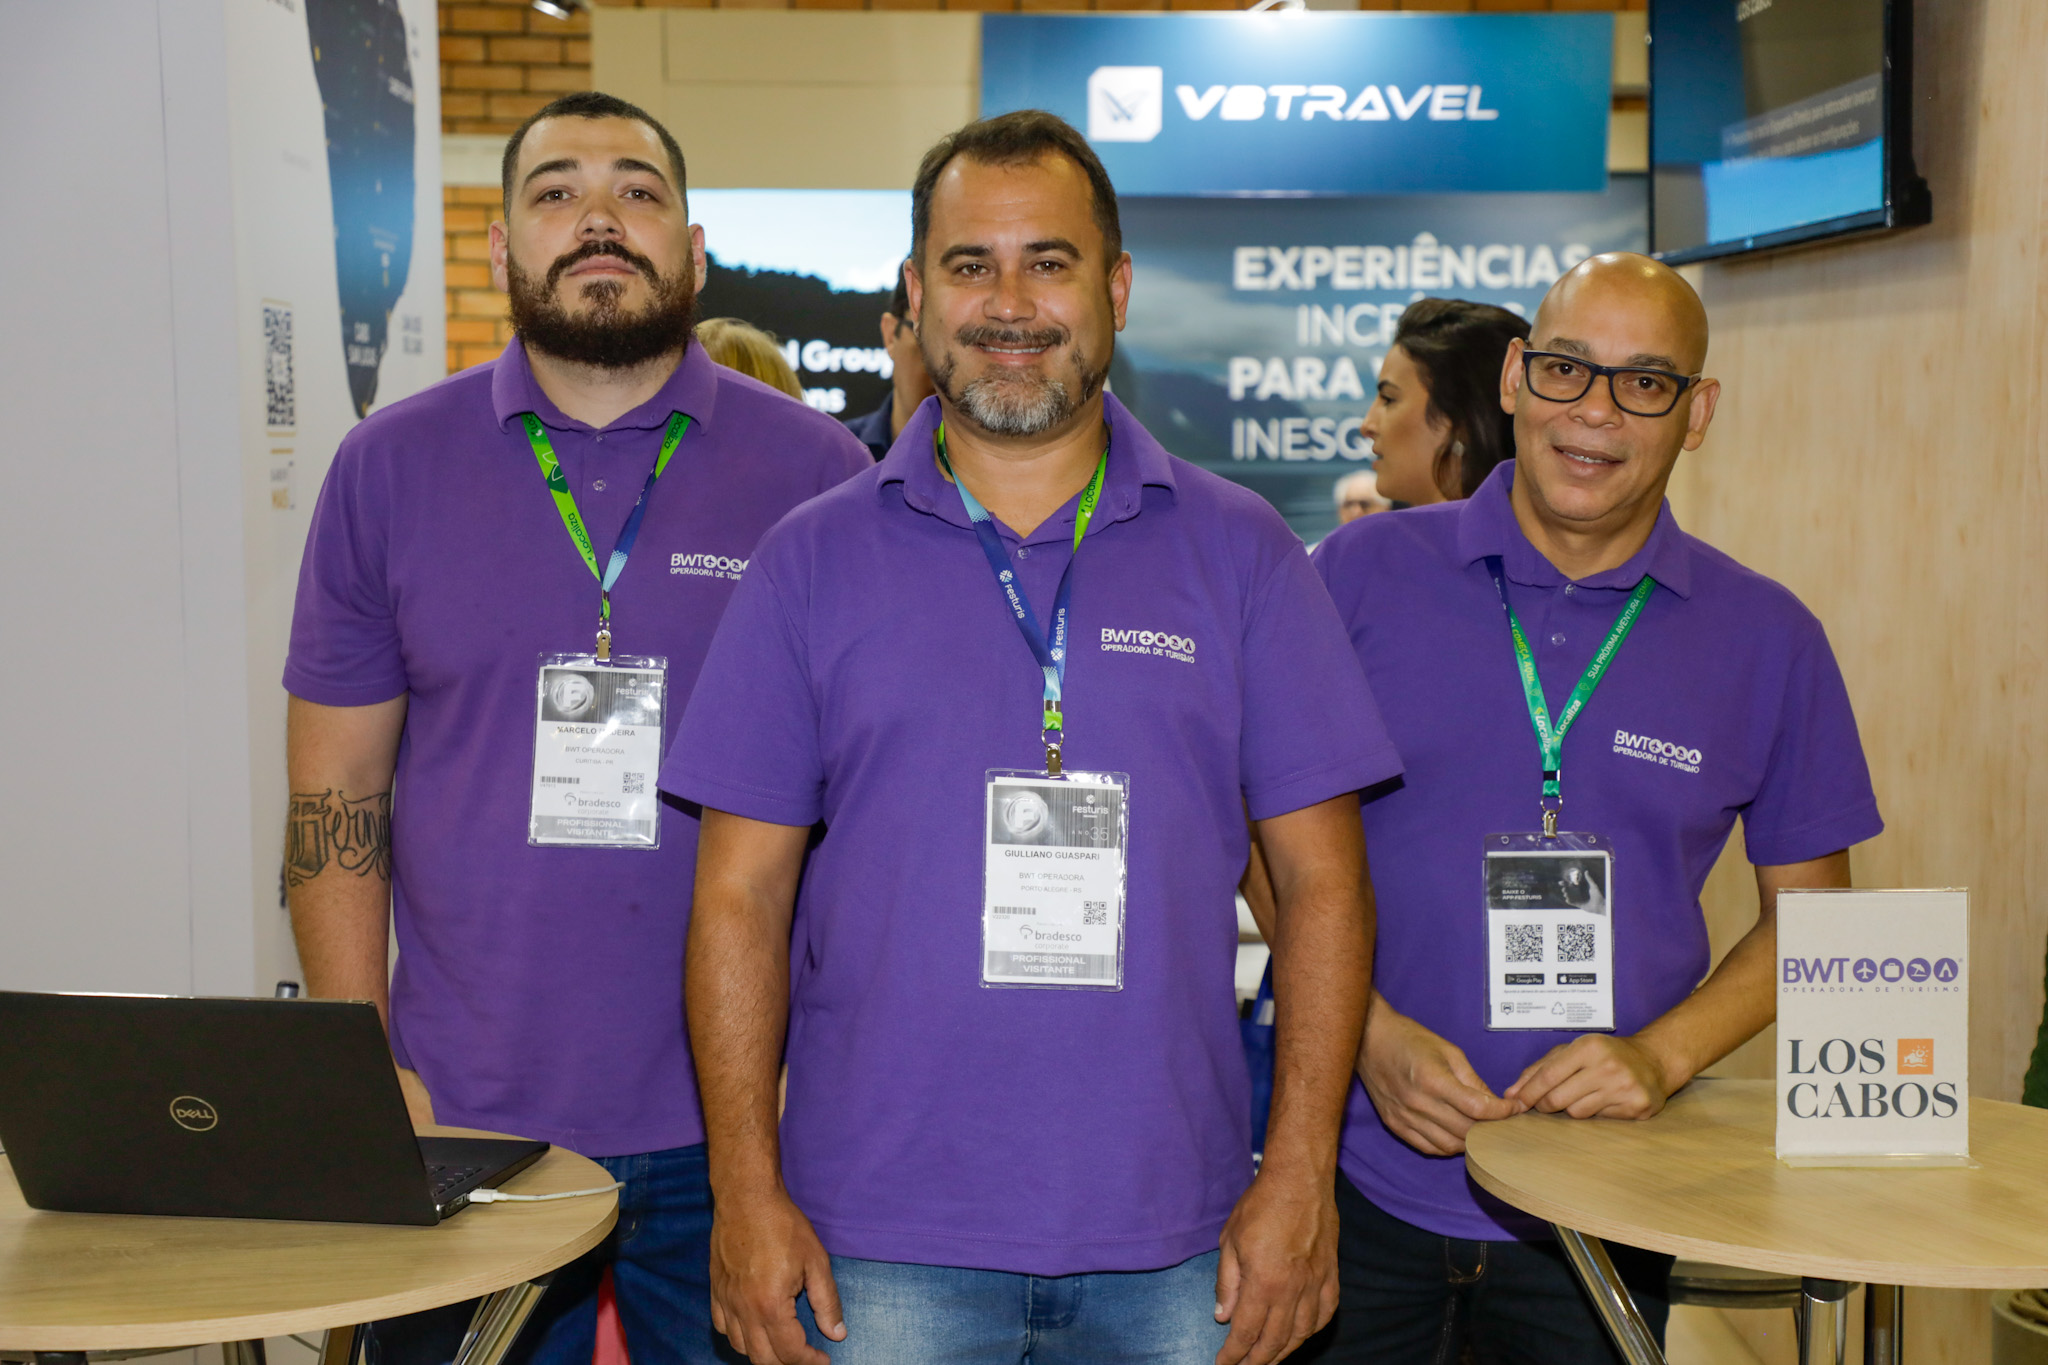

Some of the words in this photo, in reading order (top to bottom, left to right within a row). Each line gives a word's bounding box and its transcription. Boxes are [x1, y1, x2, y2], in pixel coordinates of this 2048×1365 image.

[1176, 84, 1499, 121] VBTRAVEL
[801, 339, 894, 379] Group
[1229, 357, 1365, 399] PARA
[1233, 418, 1376, 461] INESQ
[568, 512, 592, 554] Localiza
[671, 553, 705, 567] BWT
[670, 567, 714, 577] OPERADORA
[726, 572, 742, 580] TURI
[1005, 584, 1025, 619] Festuris
[1055, 608, 1066, 646] Festuris
[1101, 628, 1140, 644] BWT
[1587, 664, 1601, 679] SUA
[1596, 634, 1620, 664] PRÓXIMA
[1616, 598, 1640, 634] AVENTURA
[1101, 643, 1151, 655] OPERADORA
[1153, 647, 1163, 656] DE
[1165, 649, 1195, 664] TURISMO
[615, 686, 650, 696] Festuri
[1556, 699, 1582, 735] Localiza
[1614, 729, 1651, 750] BWT
[582, 746, 625, 755] OPERADORA
[1613, 745, 1657, 762] OPERADORA
[1658, 756, 1668, 765] DE
[1670, 759, 1700, 774] TURISMO
[578, 798, 621, 808] bradesco
[1072, 805, 1109, 815] Festuris
[557, 818, 624, 828] PROFISSIONAL
[566, 828, 614, 836] VISITANTE
[1090, 826, 1109, 841] 35
[1005, 849, 1053, 859] GIULLIANO
[1055, 851, 1100, 861] GUASPARI
[1019, 872, 1035, 880] BWT
[1037, 872, 1085, 881] OPERADORA
[1035, 930, 1082, 942] bradesco
[1034, 943, 1069, 951] corporate
[1012, 954, 1086, 965] PROFISSIONAL
[1023, 965, 1075, 974] VISITANTE
[1783, 958, 1850, 983] BWT
[1787, 1038, 1885, 1074] LOS
[1787, 1082, 1958, 1118] CABOS
